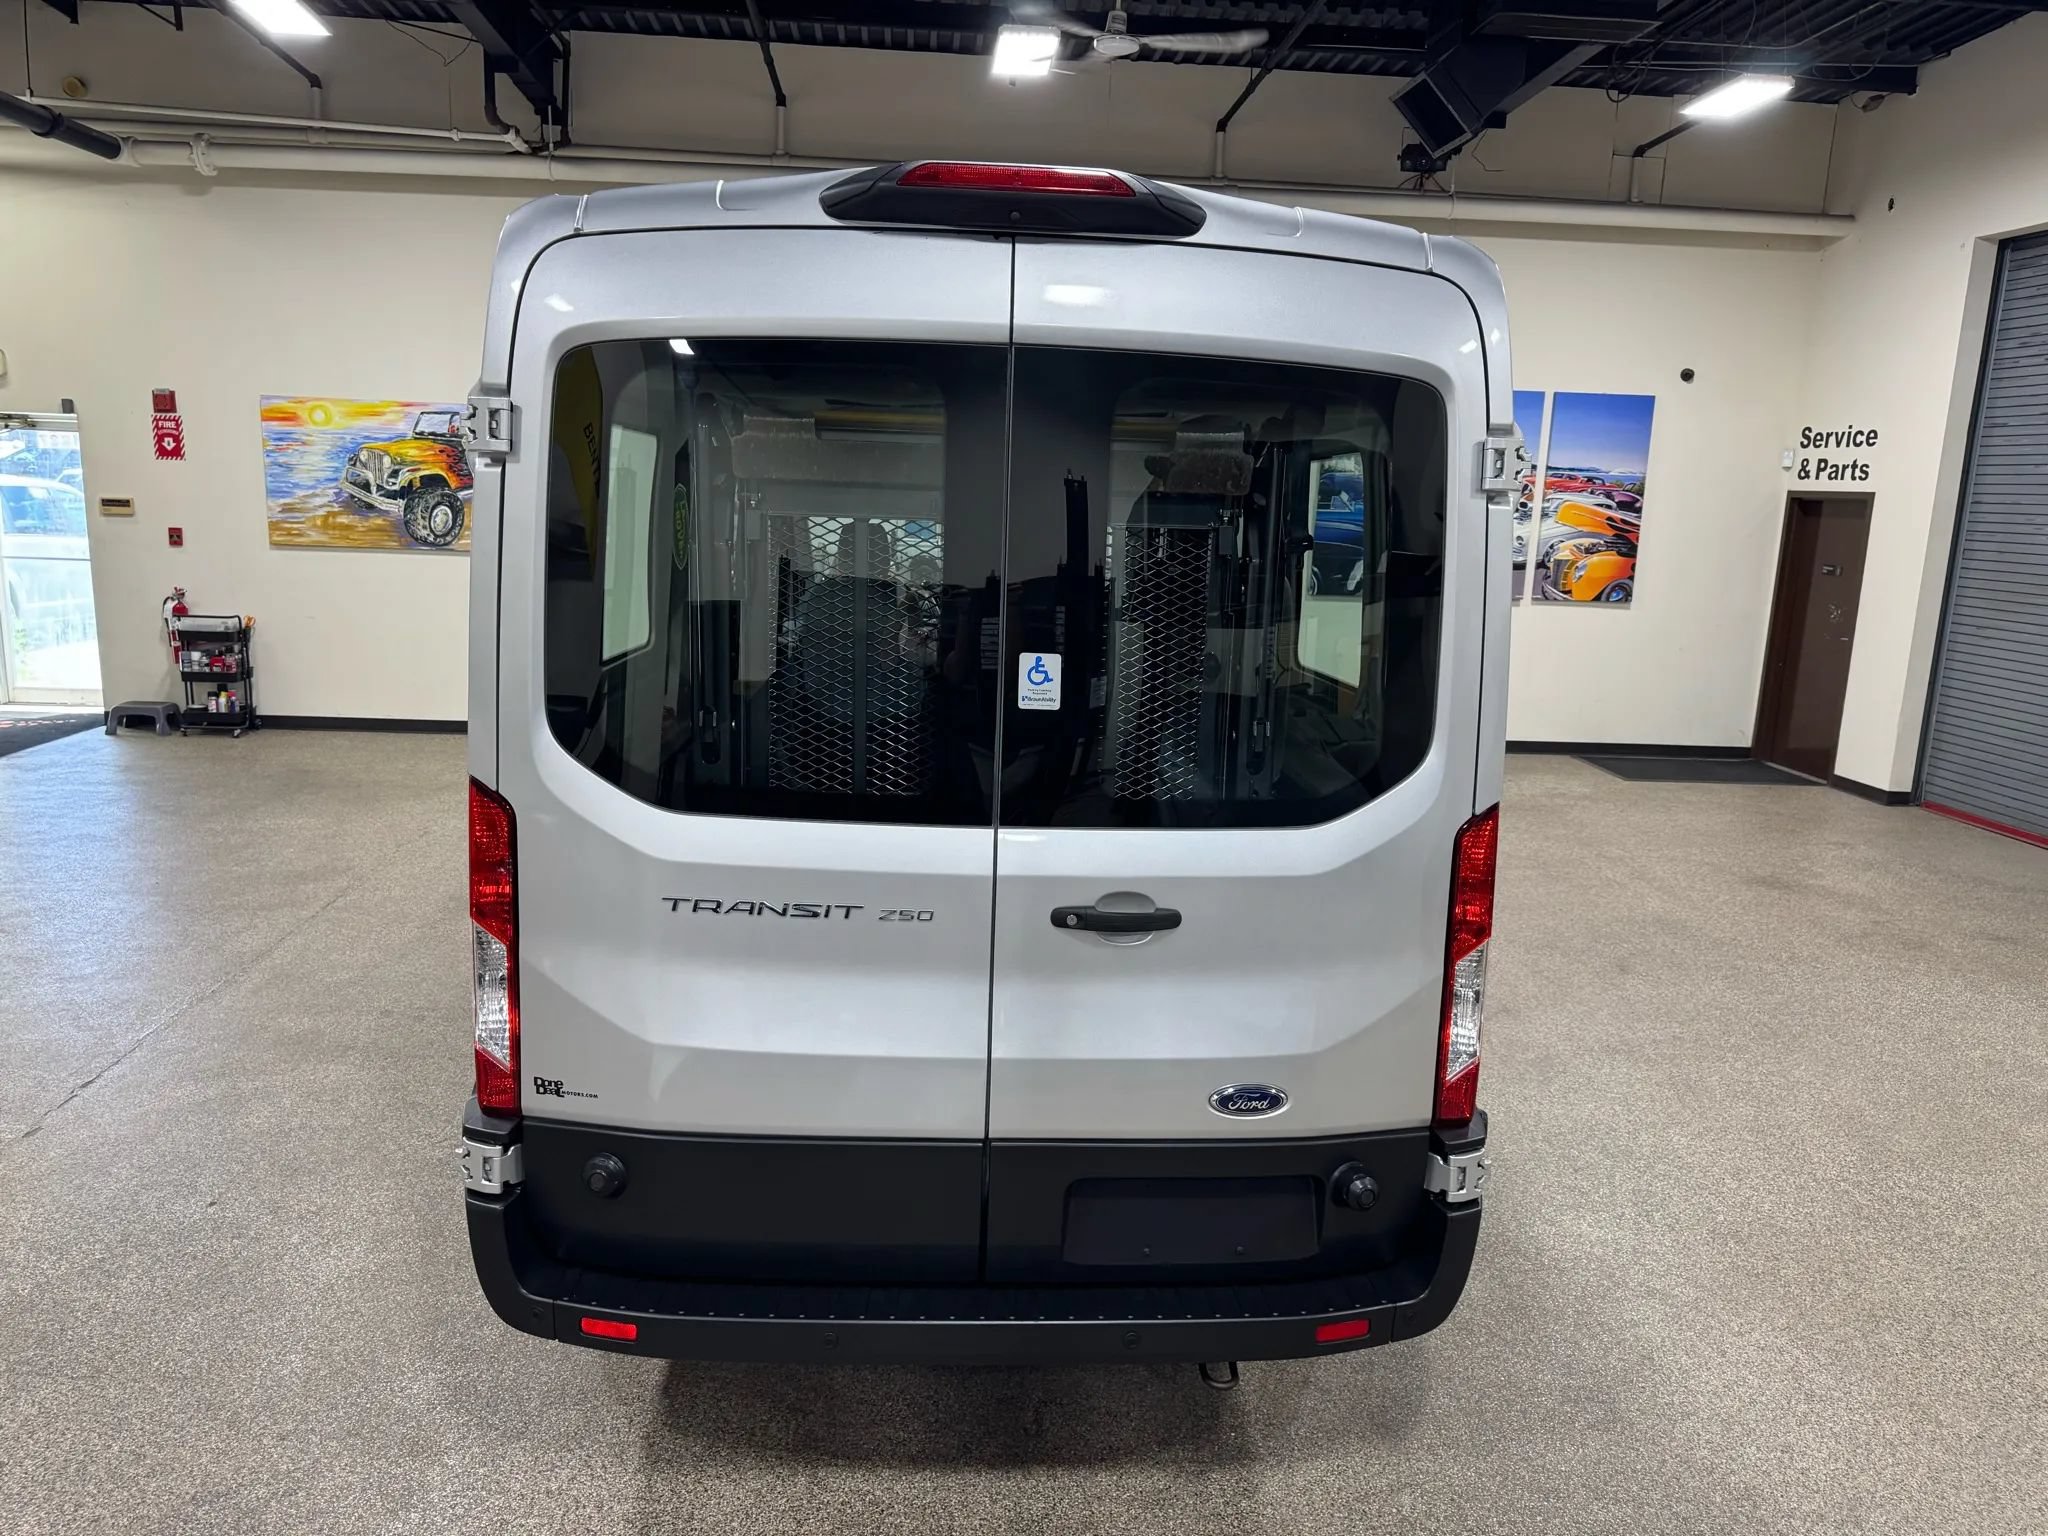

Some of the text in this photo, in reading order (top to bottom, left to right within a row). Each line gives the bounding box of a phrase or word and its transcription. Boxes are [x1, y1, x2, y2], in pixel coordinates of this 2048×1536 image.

[158, 420, 177, 429] FIRE
[1800, 425, 1879, 449] Service
[1797, 458, 1870, 481] & Parts
[662, 897, 935, 921] TRANSIT 250
[533, 1076, 564, 1089] Done
[1228, 1093, 1272, 1110] Ford
